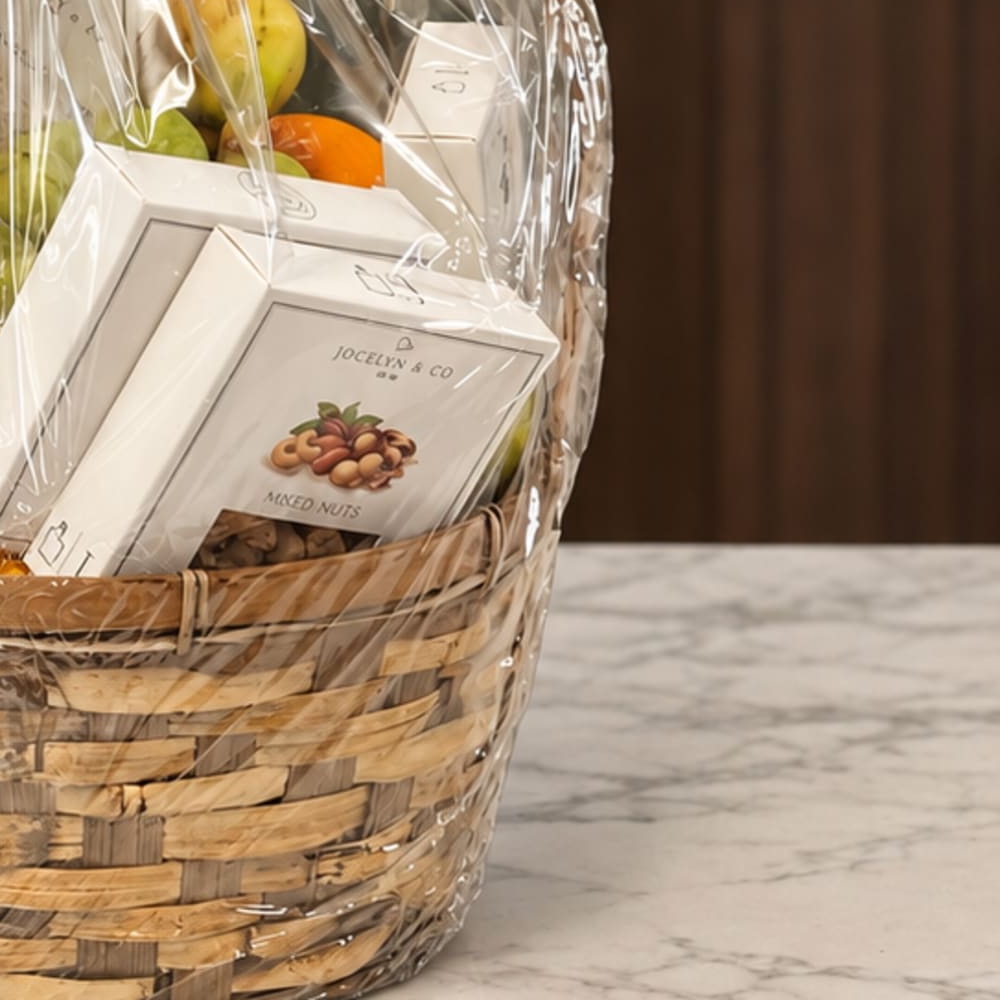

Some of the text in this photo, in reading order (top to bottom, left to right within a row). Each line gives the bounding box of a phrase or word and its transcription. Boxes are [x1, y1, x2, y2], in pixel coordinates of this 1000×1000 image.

[332, 345, 407, 370] JOCELYN
[429, 364, 454, 380] CO
[317, 502, 362, 519] NUTS
